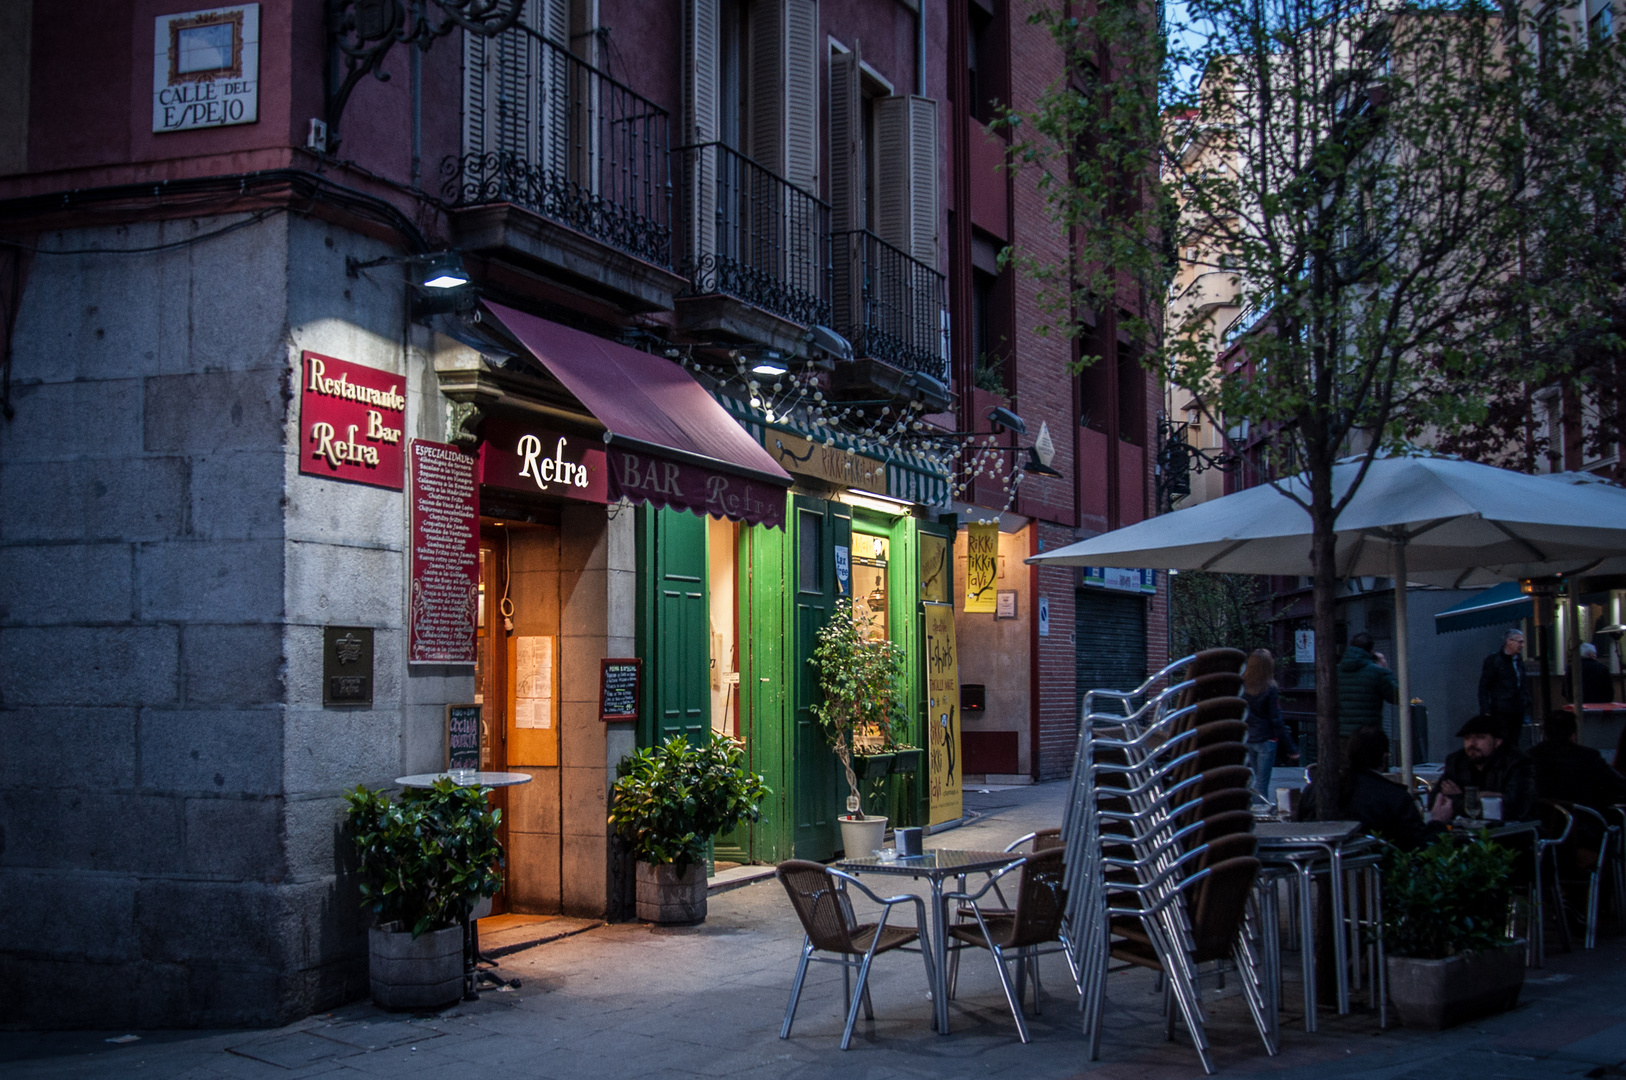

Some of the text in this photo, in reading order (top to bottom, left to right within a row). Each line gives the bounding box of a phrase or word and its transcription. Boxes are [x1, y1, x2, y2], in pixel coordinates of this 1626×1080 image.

[160, 80, 251, 105] CALLE DEL
[163, 98, 243, 129] ESPEJO
[307, 358, 404, 410] Restaurante
[367, 410, 401, 442] Bar
[312, 422, 380, 466] Refra
[415, 445, 474, 465] ESPECIALIDADES
[517, 434, 589, 490] Refra
[622, 453, 780, 517] BAR Refra
[836, 552, 846, 565] tax
